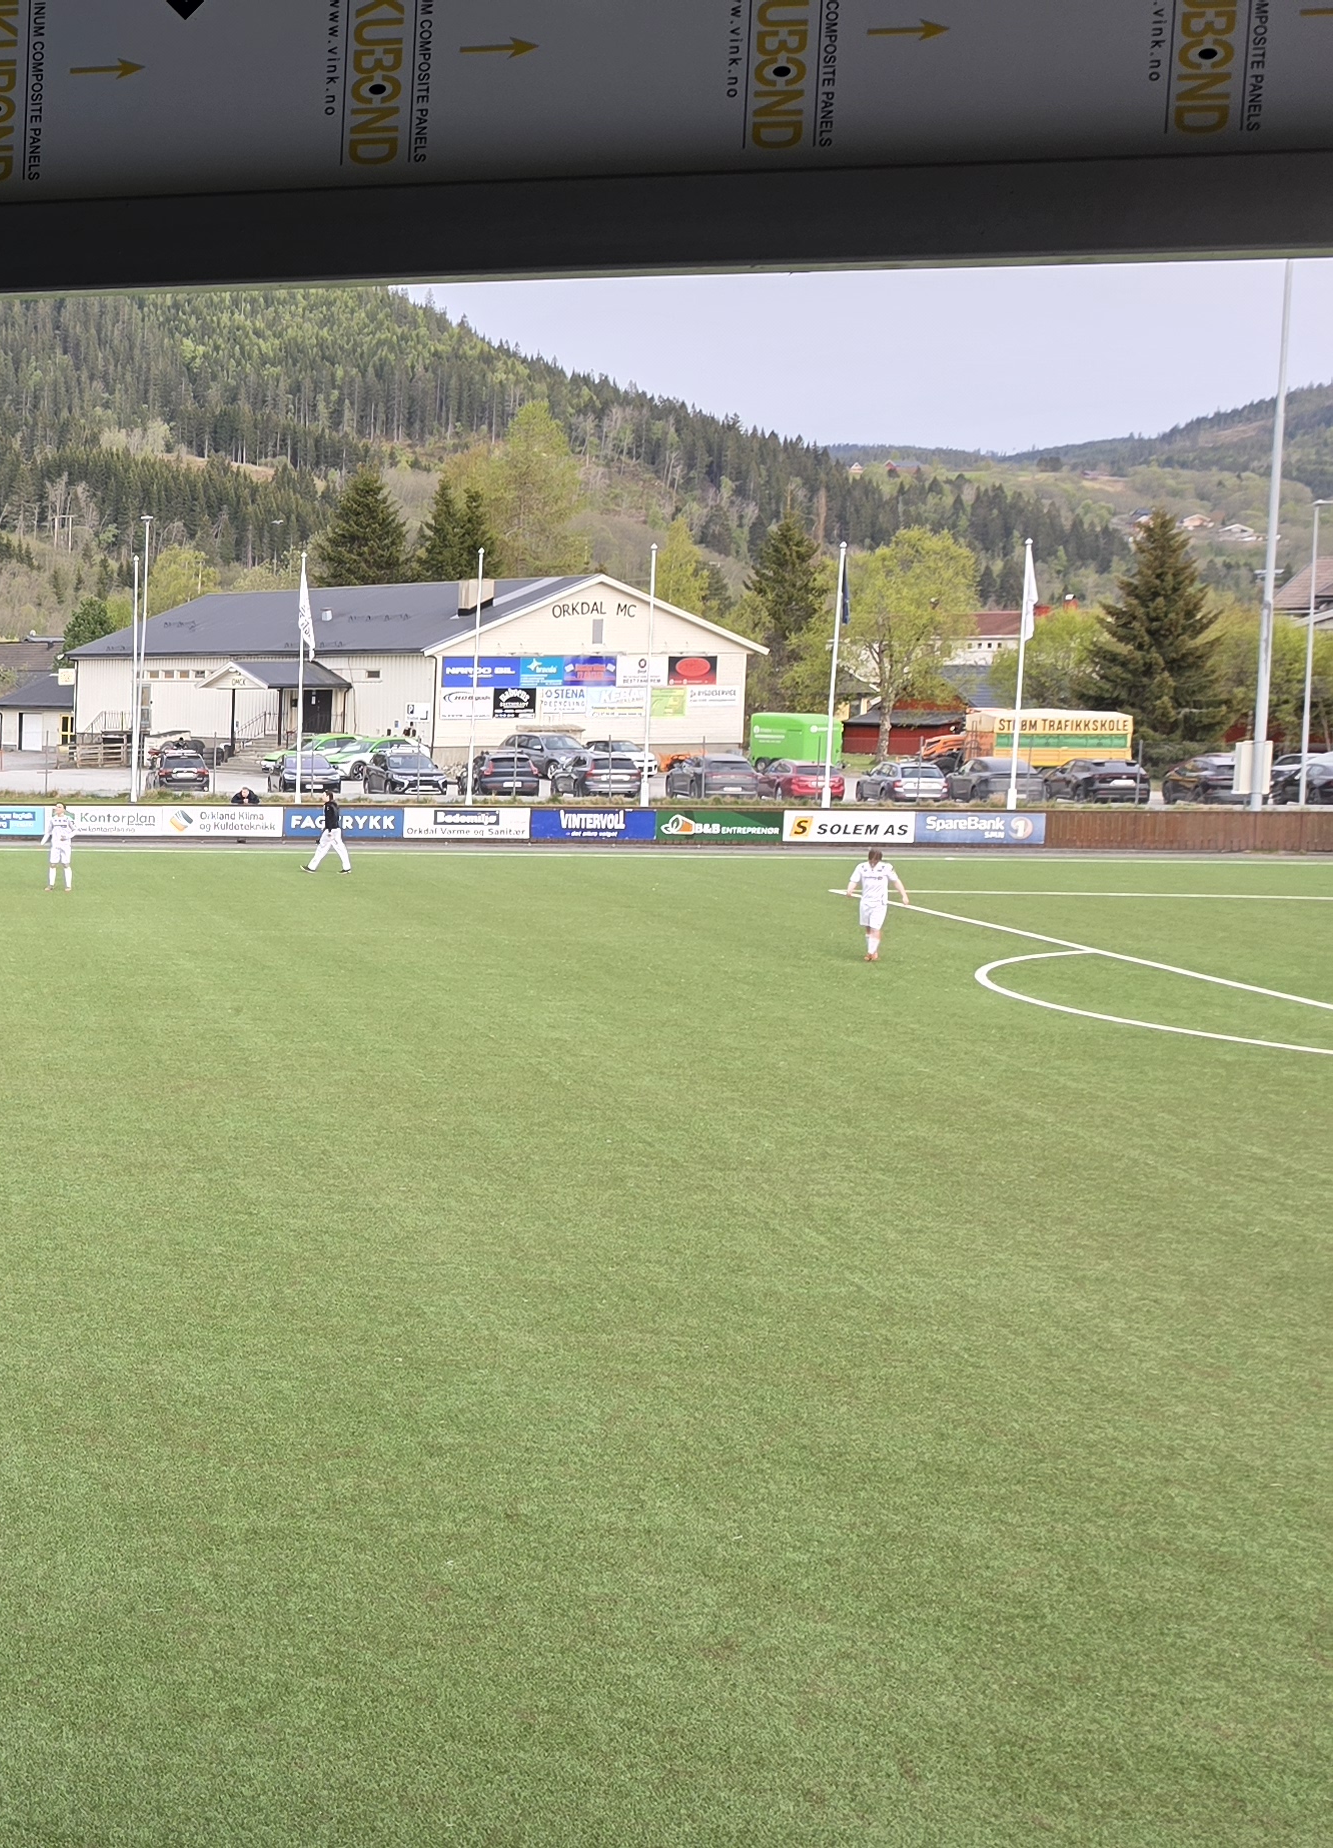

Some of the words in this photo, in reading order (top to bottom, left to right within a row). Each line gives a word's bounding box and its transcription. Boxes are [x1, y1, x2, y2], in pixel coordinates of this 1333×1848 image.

[820, 1, 840, 88] COMPOSITE
[1249, 0, 1270, 70] MPOSITE
[726, 0, 744, 99] w.vink.no
[416, 19, 433, 104] COMPOSITE
[29, 40, 45, 124] COMPOSITE
[346, 0, 406, 166] KUBOND
[1245, 73, 1264, 132] PANELS
[816, 90, 835, 148] PANELS
[413, 108, 429, 163] PANELS
[27, 127, 42, 182] PANELS
[551, 601, 607, 618] ORKDAL
[615, 602, 637, 618] MC
[553, 688, 585, 699] STENA
[1041, 718, 1129, 732] TRAFIKKSKOLE
[80, 812, 156, 825] Kontorplan
[199, 811, 236, 820] Orkland
[238, 811, 265, 820] Klima
[290, 815, 396, 830] FAGRYKK
[559, 809, 626, 830] VINTERVOLL
[925, 815, 1005, 832] SpareBank
[199, 823, 211, 832] og
[213, 822, 276, 831] Kuldeteknikk
[406, 827, 437, 835] Orkdal
[473, 828, 484, 836] og
[693, 823, 721, 834] B&B
[793, 819, 809, 835] S
[816, 823, 880, 836] SOLEM
[883, 824, 909, 836] AS
